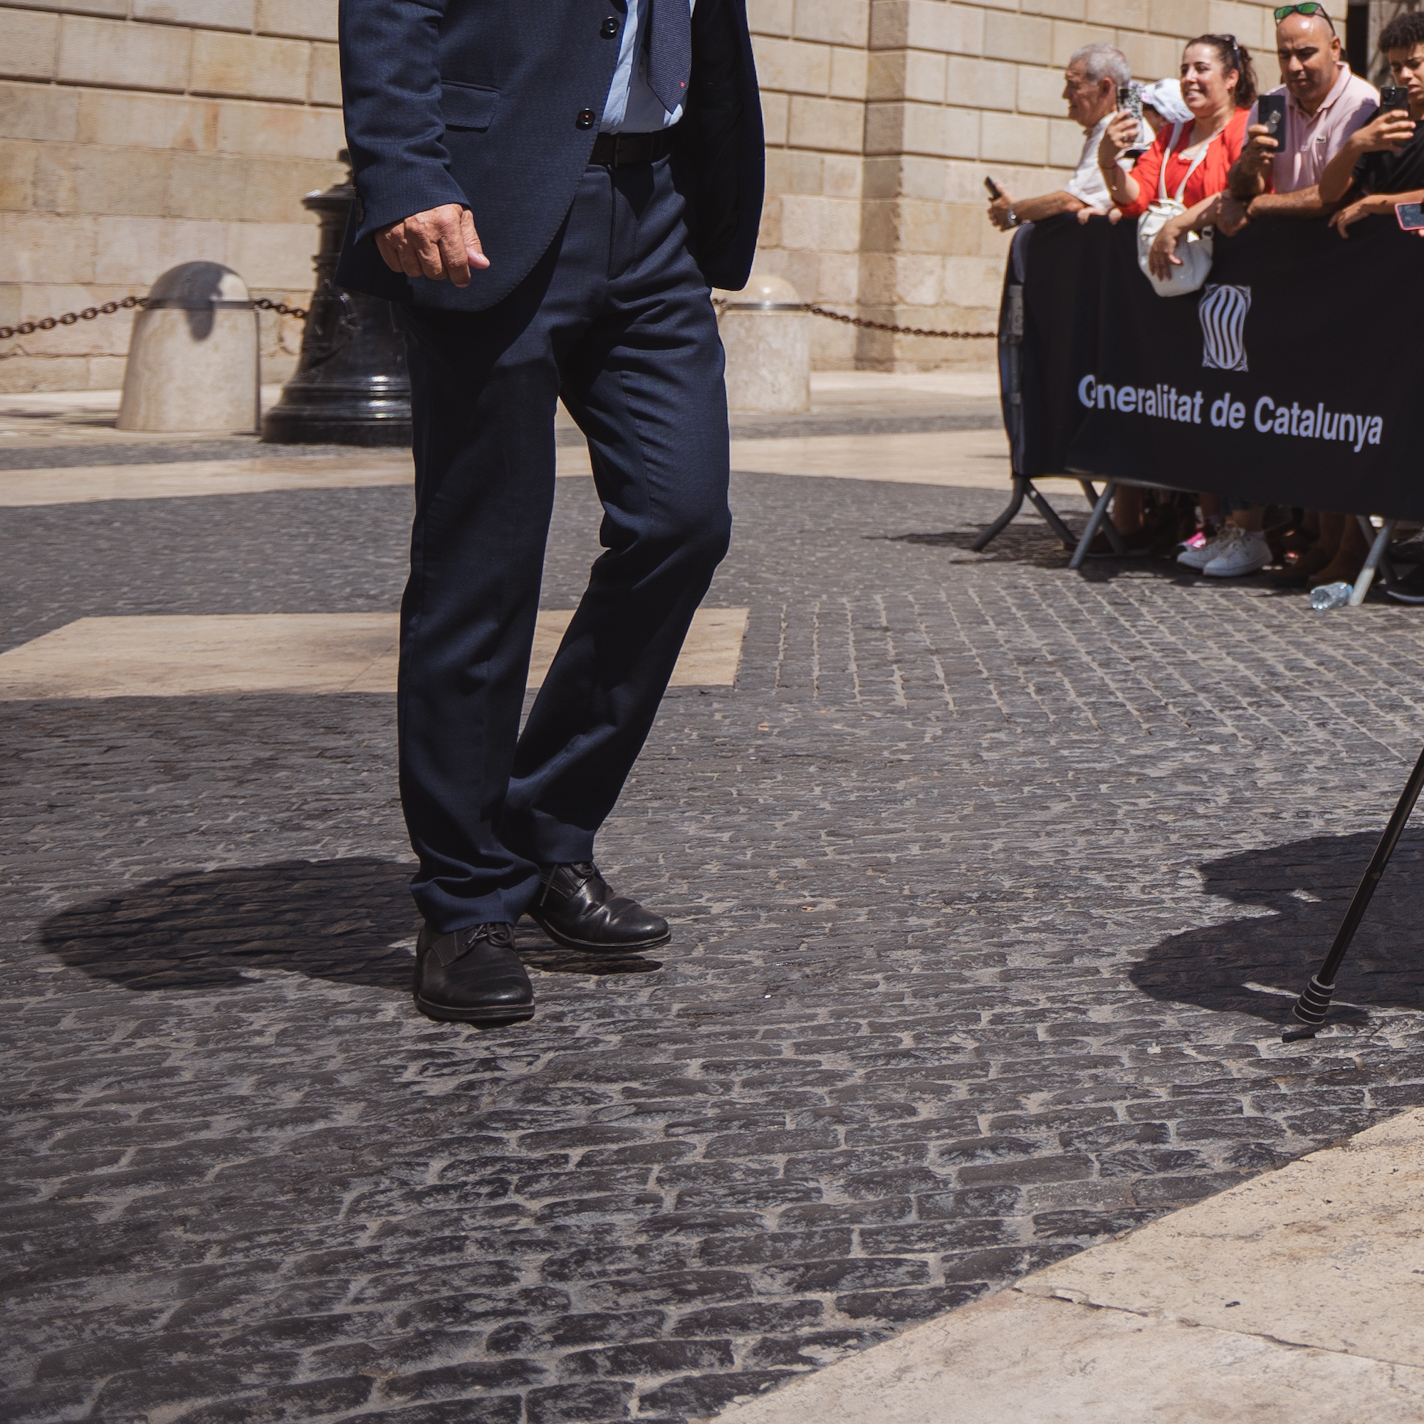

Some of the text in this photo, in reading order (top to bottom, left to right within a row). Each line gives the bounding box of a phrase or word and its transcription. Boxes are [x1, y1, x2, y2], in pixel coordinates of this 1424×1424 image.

[1078, 374, 1383, 453] Gneralitat de Catalunya
